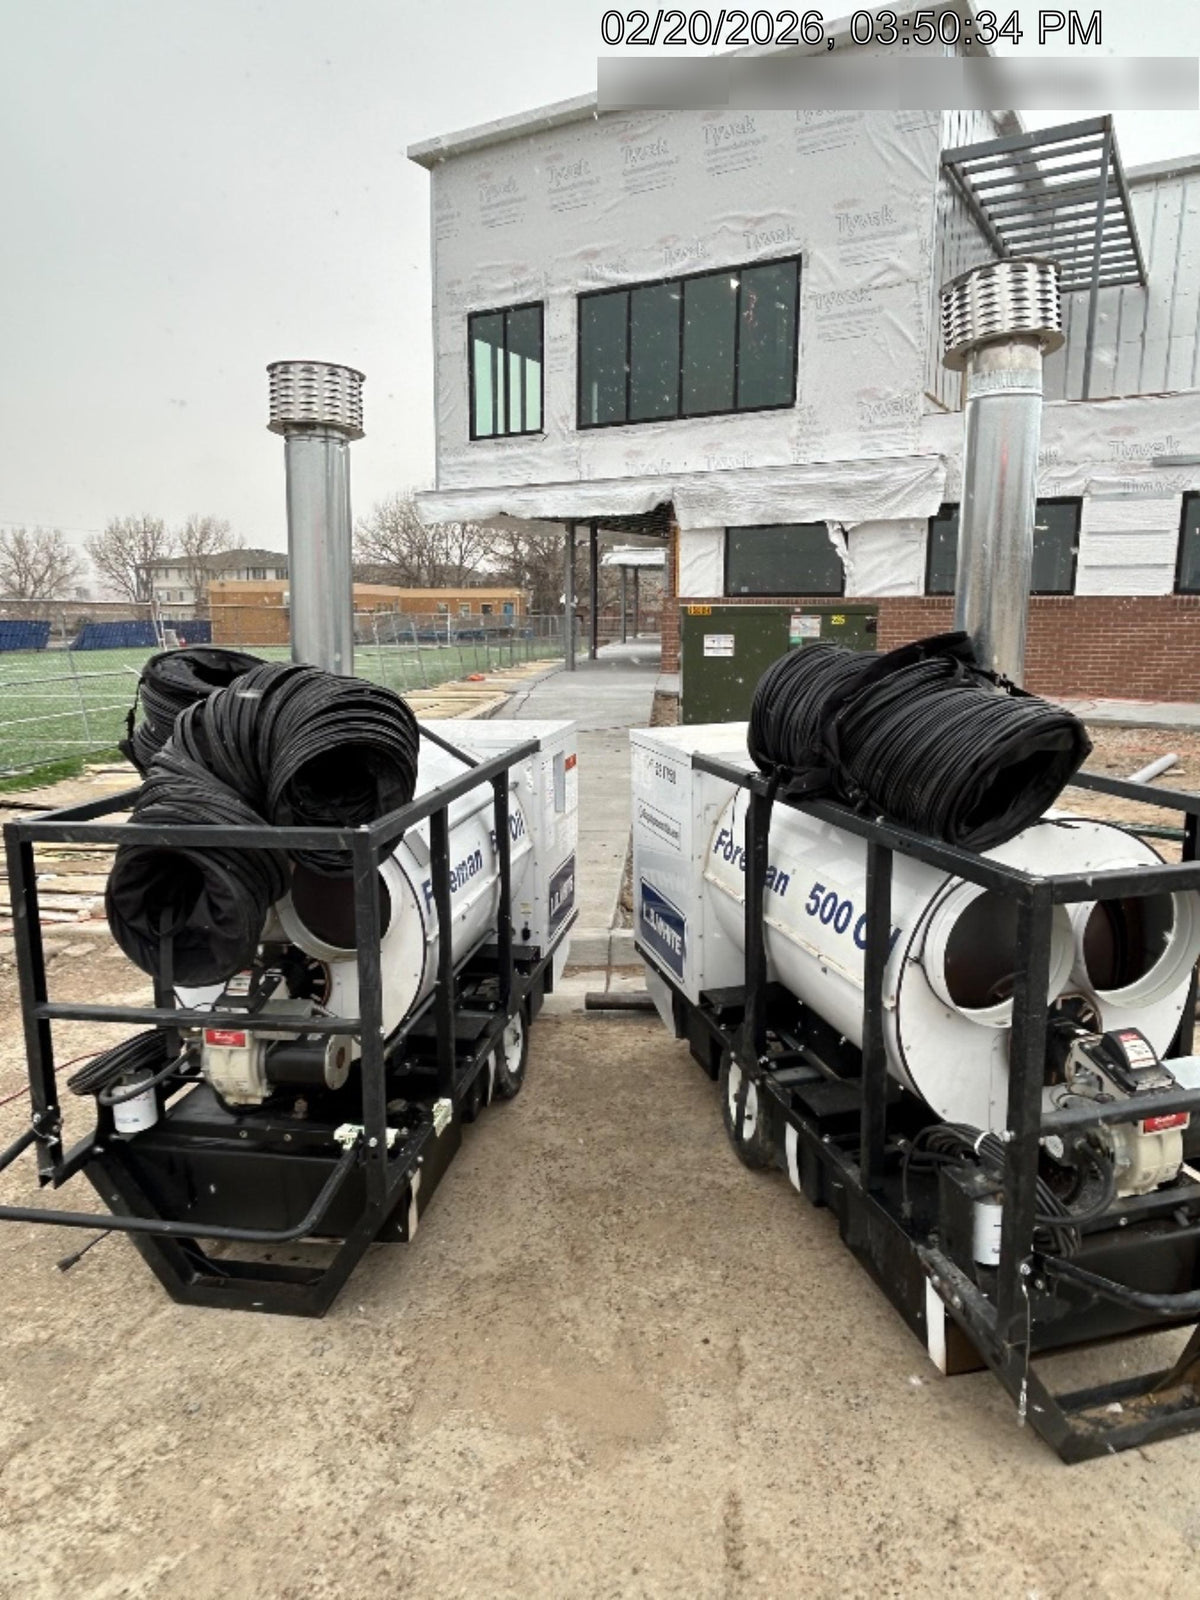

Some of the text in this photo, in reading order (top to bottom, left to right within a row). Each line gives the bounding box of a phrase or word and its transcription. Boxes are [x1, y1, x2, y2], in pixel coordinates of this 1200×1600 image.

[835, 204, 897, 236] Tyvek
[421, 848, 483, 915] Feman
[714, 827, 790, 896] Forean
[805, 882, 854, 935] 500
